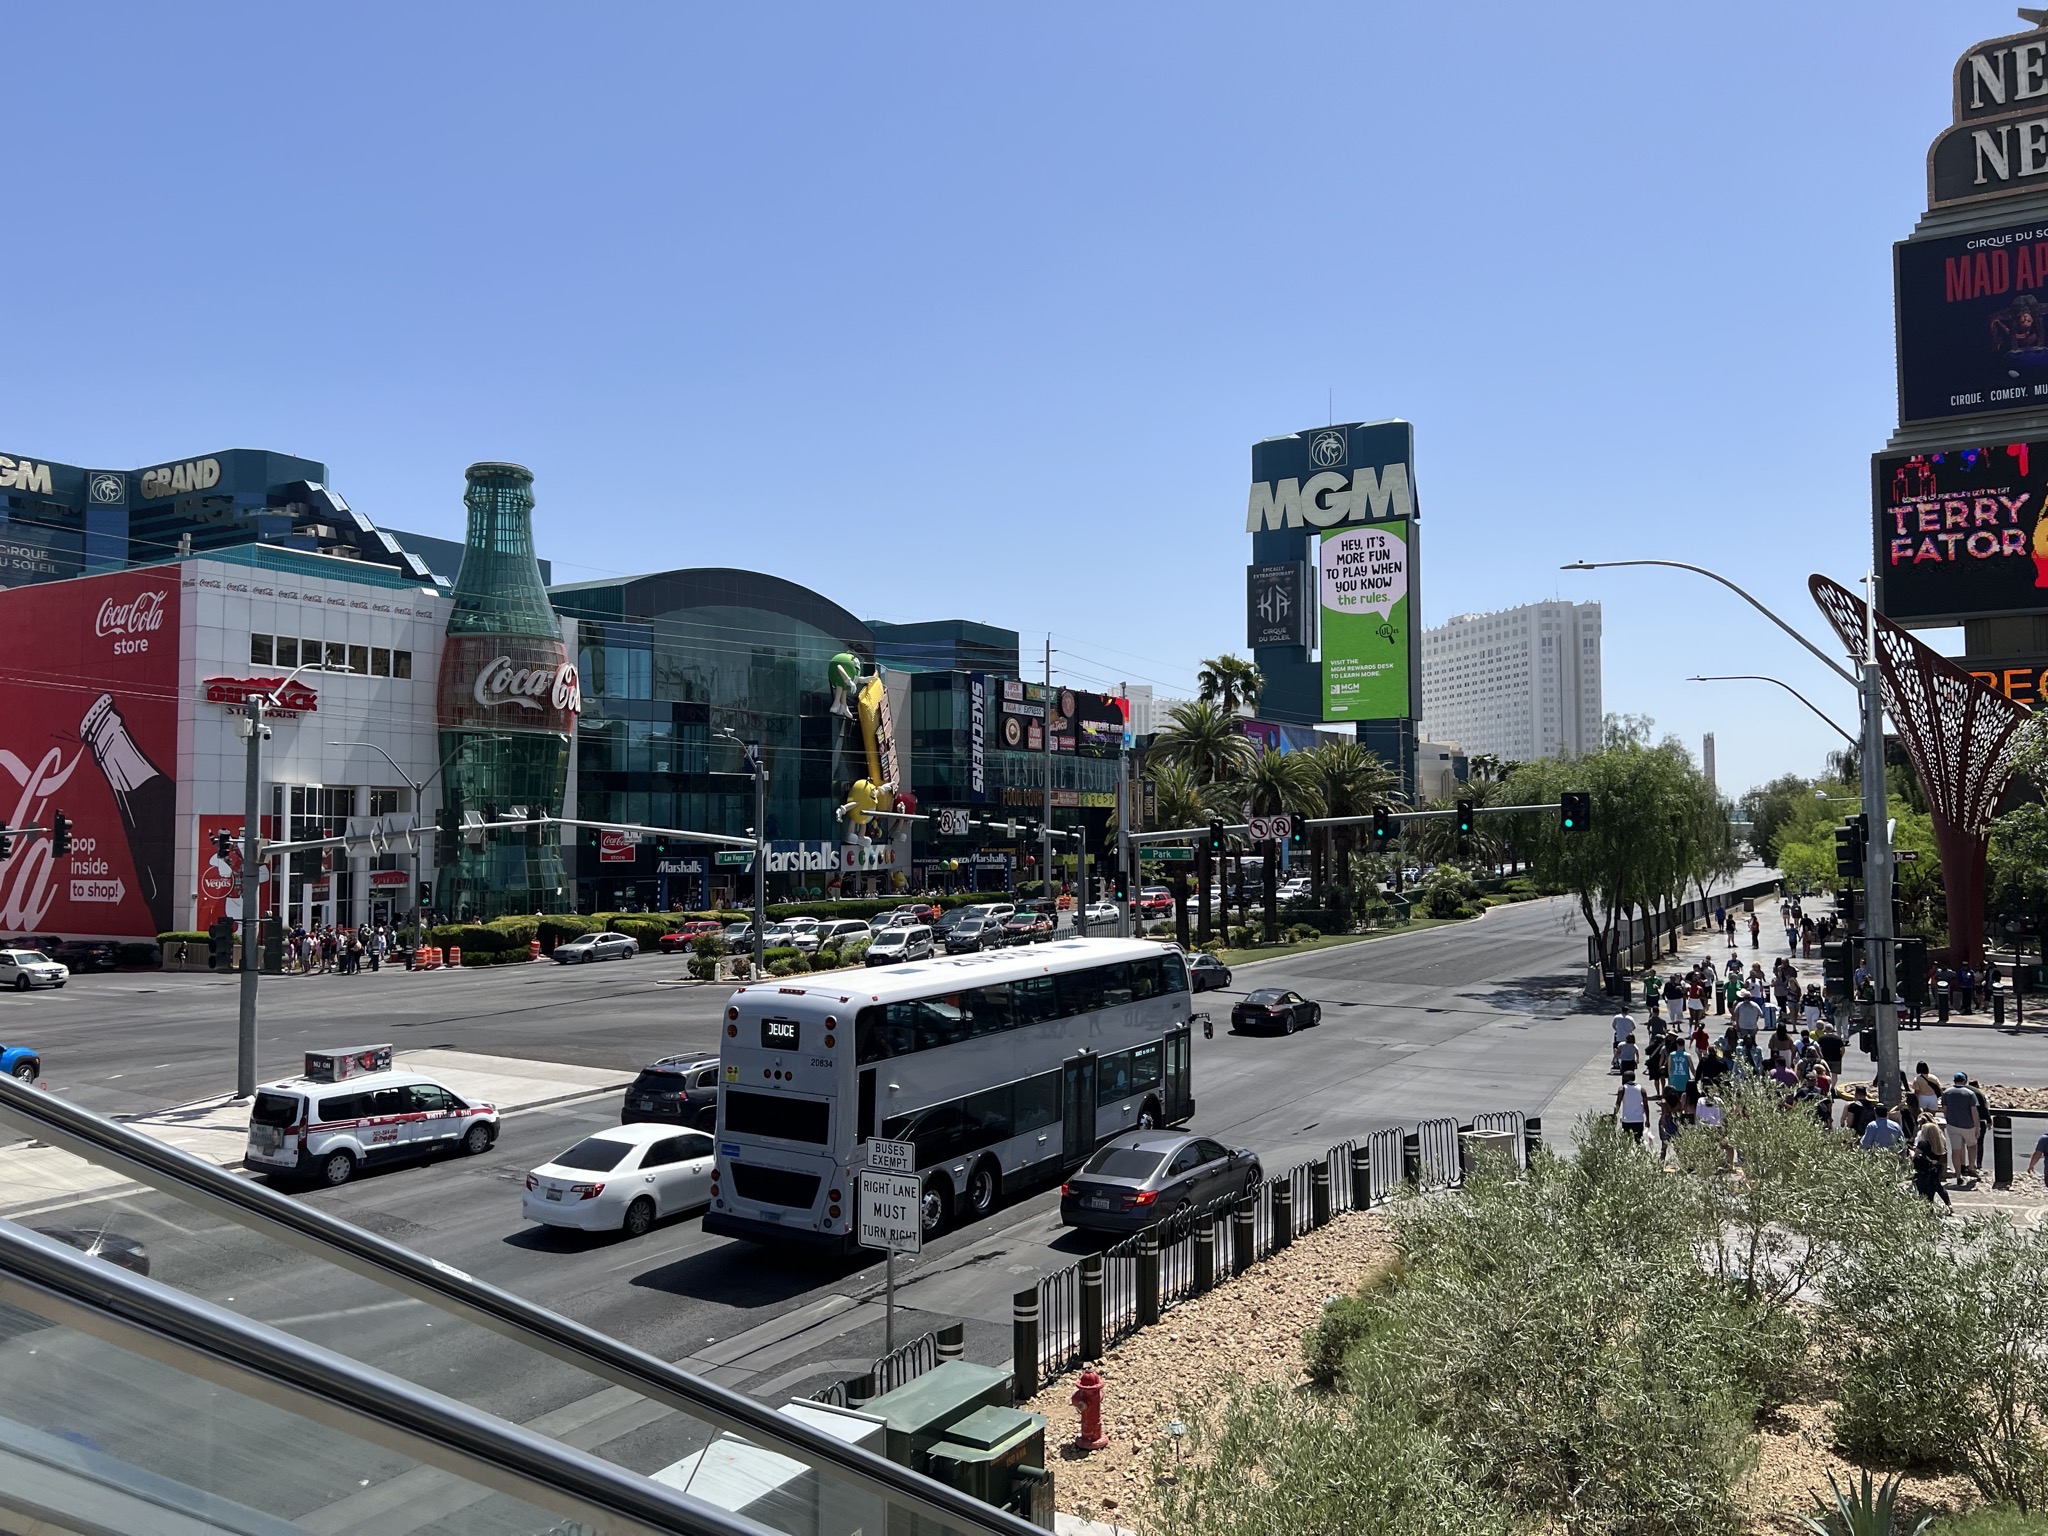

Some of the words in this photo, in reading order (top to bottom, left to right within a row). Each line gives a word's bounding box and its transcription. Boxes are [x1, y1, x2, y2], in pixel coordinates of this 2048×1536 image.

[1967, 234, 2012, 249] CIRQUE
[2015, 231, 2033, 242] DU
[1945, 249, 2010, 303] MAD
[1950, 392, 1984, 406] CIRQUE.
[1990, 386, 2028, 401] COMEDY.
[140, 458, 221, 500] GRAND
[1246, 462, 1412, 533] MGM
[1887, 492, 2031, 535] TERRY
[1367, 536, 1385, 549] IT'S
[1891, 528, 2027, 566] FATOR
[1337, 552, 1365, 565] MORE
[1369, 549, 1390, 562] FUN
[12, 559, 59, 574] SOLEIL
[1326, 568, 1339, 579] TO
[1343, 565, 1367, 578] PLAY
[1371, 561, 1402, 575] WHEN
[1335, 580, 1357, 592] YOU
[1361, 576, 1392, 590] KNOW
[1338, 594, 1356, 605] the
[1360, 591, 1390, 604] rules.
[95, 590, 168, 637] Coca-Cola
[1263, 627, 1287, 636] CIRQUE
[1269, 634, 1291, 642] SOLEIL
[114, 639, 149, 655] store
[474, 655, 580, 713] Coca-Col
[1008, 682, 1019, 691] OPEN
[206, 685, 317, 711] OUTACK
[972, 680, 984, 793] SKECHERS
[1029, 728, 1041, 738] FOOD
[1028, 738, 1042, 748] COURT
[1002, 756, 1065, 789] WESTGTE
[71, 837, 96, 855] pop
[1152, 849, 1172, 859] Park
[71, 857, 109, 875] inside
[724, 852, 732, 861] Las
[733, 852, 745, 863] Vegas
[744, 841, 840, 874] Marshalls
[969, 853, 1008, 863] Marshalls
[656, 861, 703, 874] Marshalls
[73, 882, 85, 897] to
[88, 881, 118, 901] shop!
[205, 878, 231, 890] Vegas
[811, 1058, 833, 1068] 20834
[875, 1142, 905, 1156] BUSES
[872, 1154, 907, 1169] EXEMPT
[863, 1180, 890, 1195] RIGHT
[893, 1183, 917, 1198] LANE
[873, 1202, 906, 1220] MUST
[862, 1223, 887, 1238] TURN
[890, 1228, 917, 1241] RIGHT
